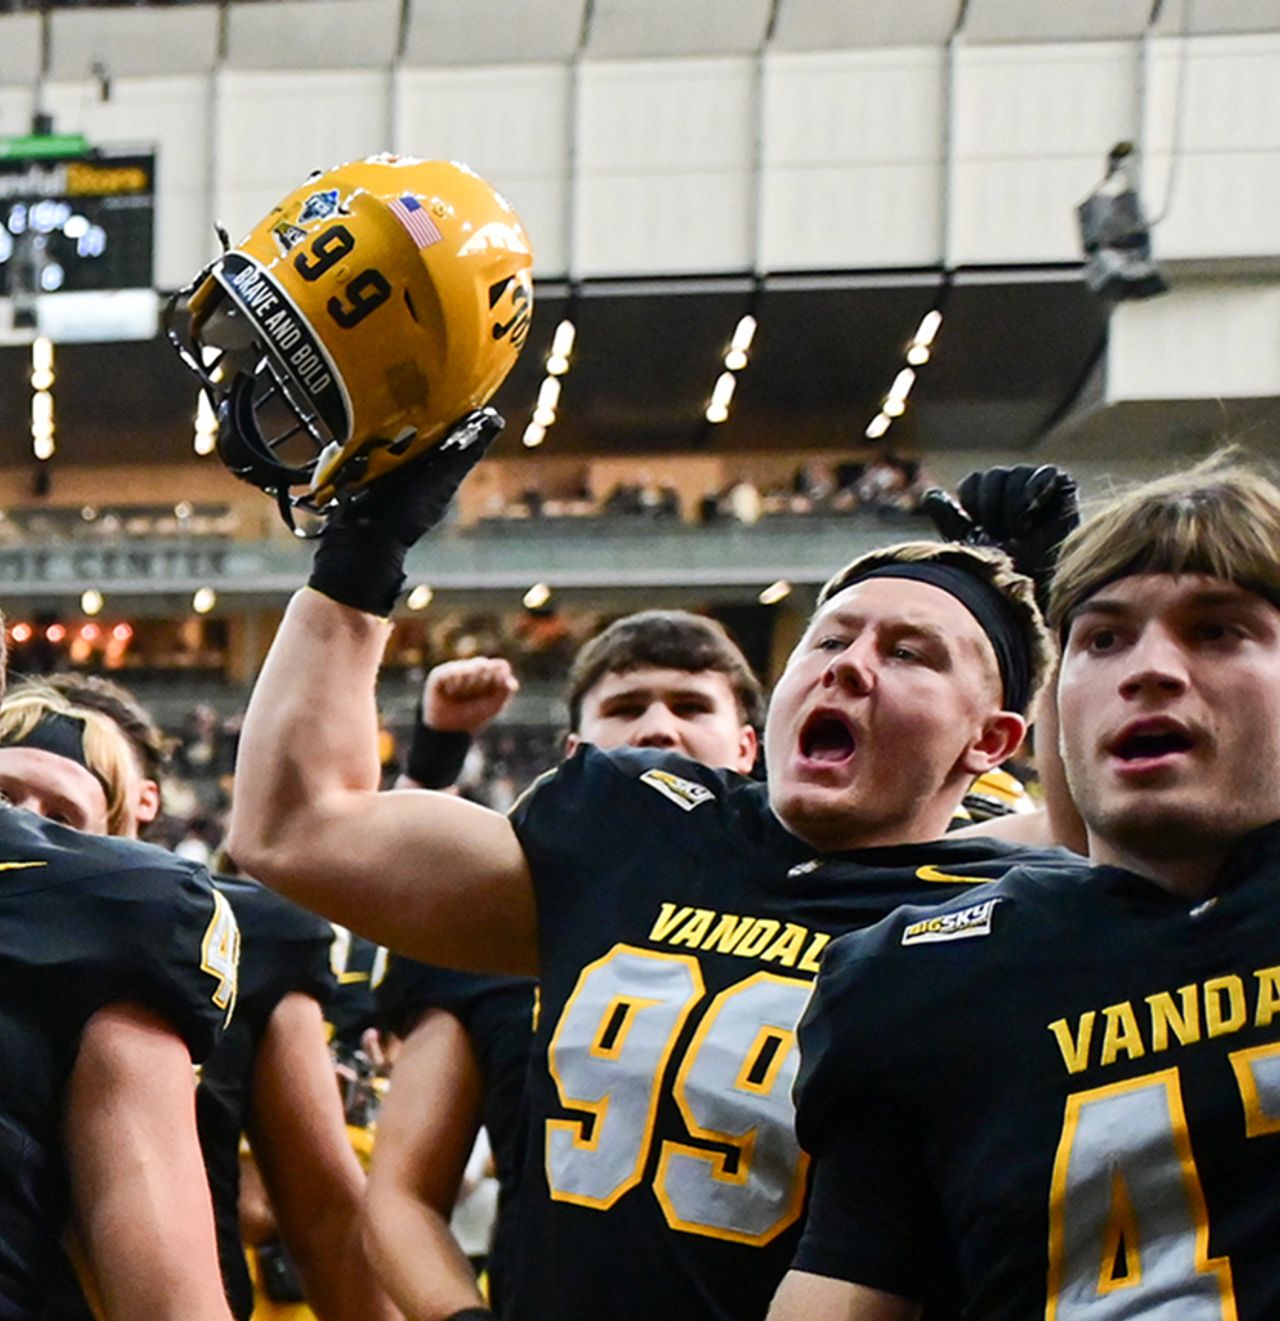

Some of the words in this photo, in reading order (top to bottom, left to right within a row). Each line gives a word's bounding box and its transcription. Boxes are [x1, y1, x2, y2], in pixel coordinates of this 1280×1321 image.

[235, 264, 280, 319] BRAVE
[264, 309, 301, 352] AND
[292, 342, 333, 396] BOLD
[293, 224, 393, 330] 99
[545, 942, 820, 1248] 99
